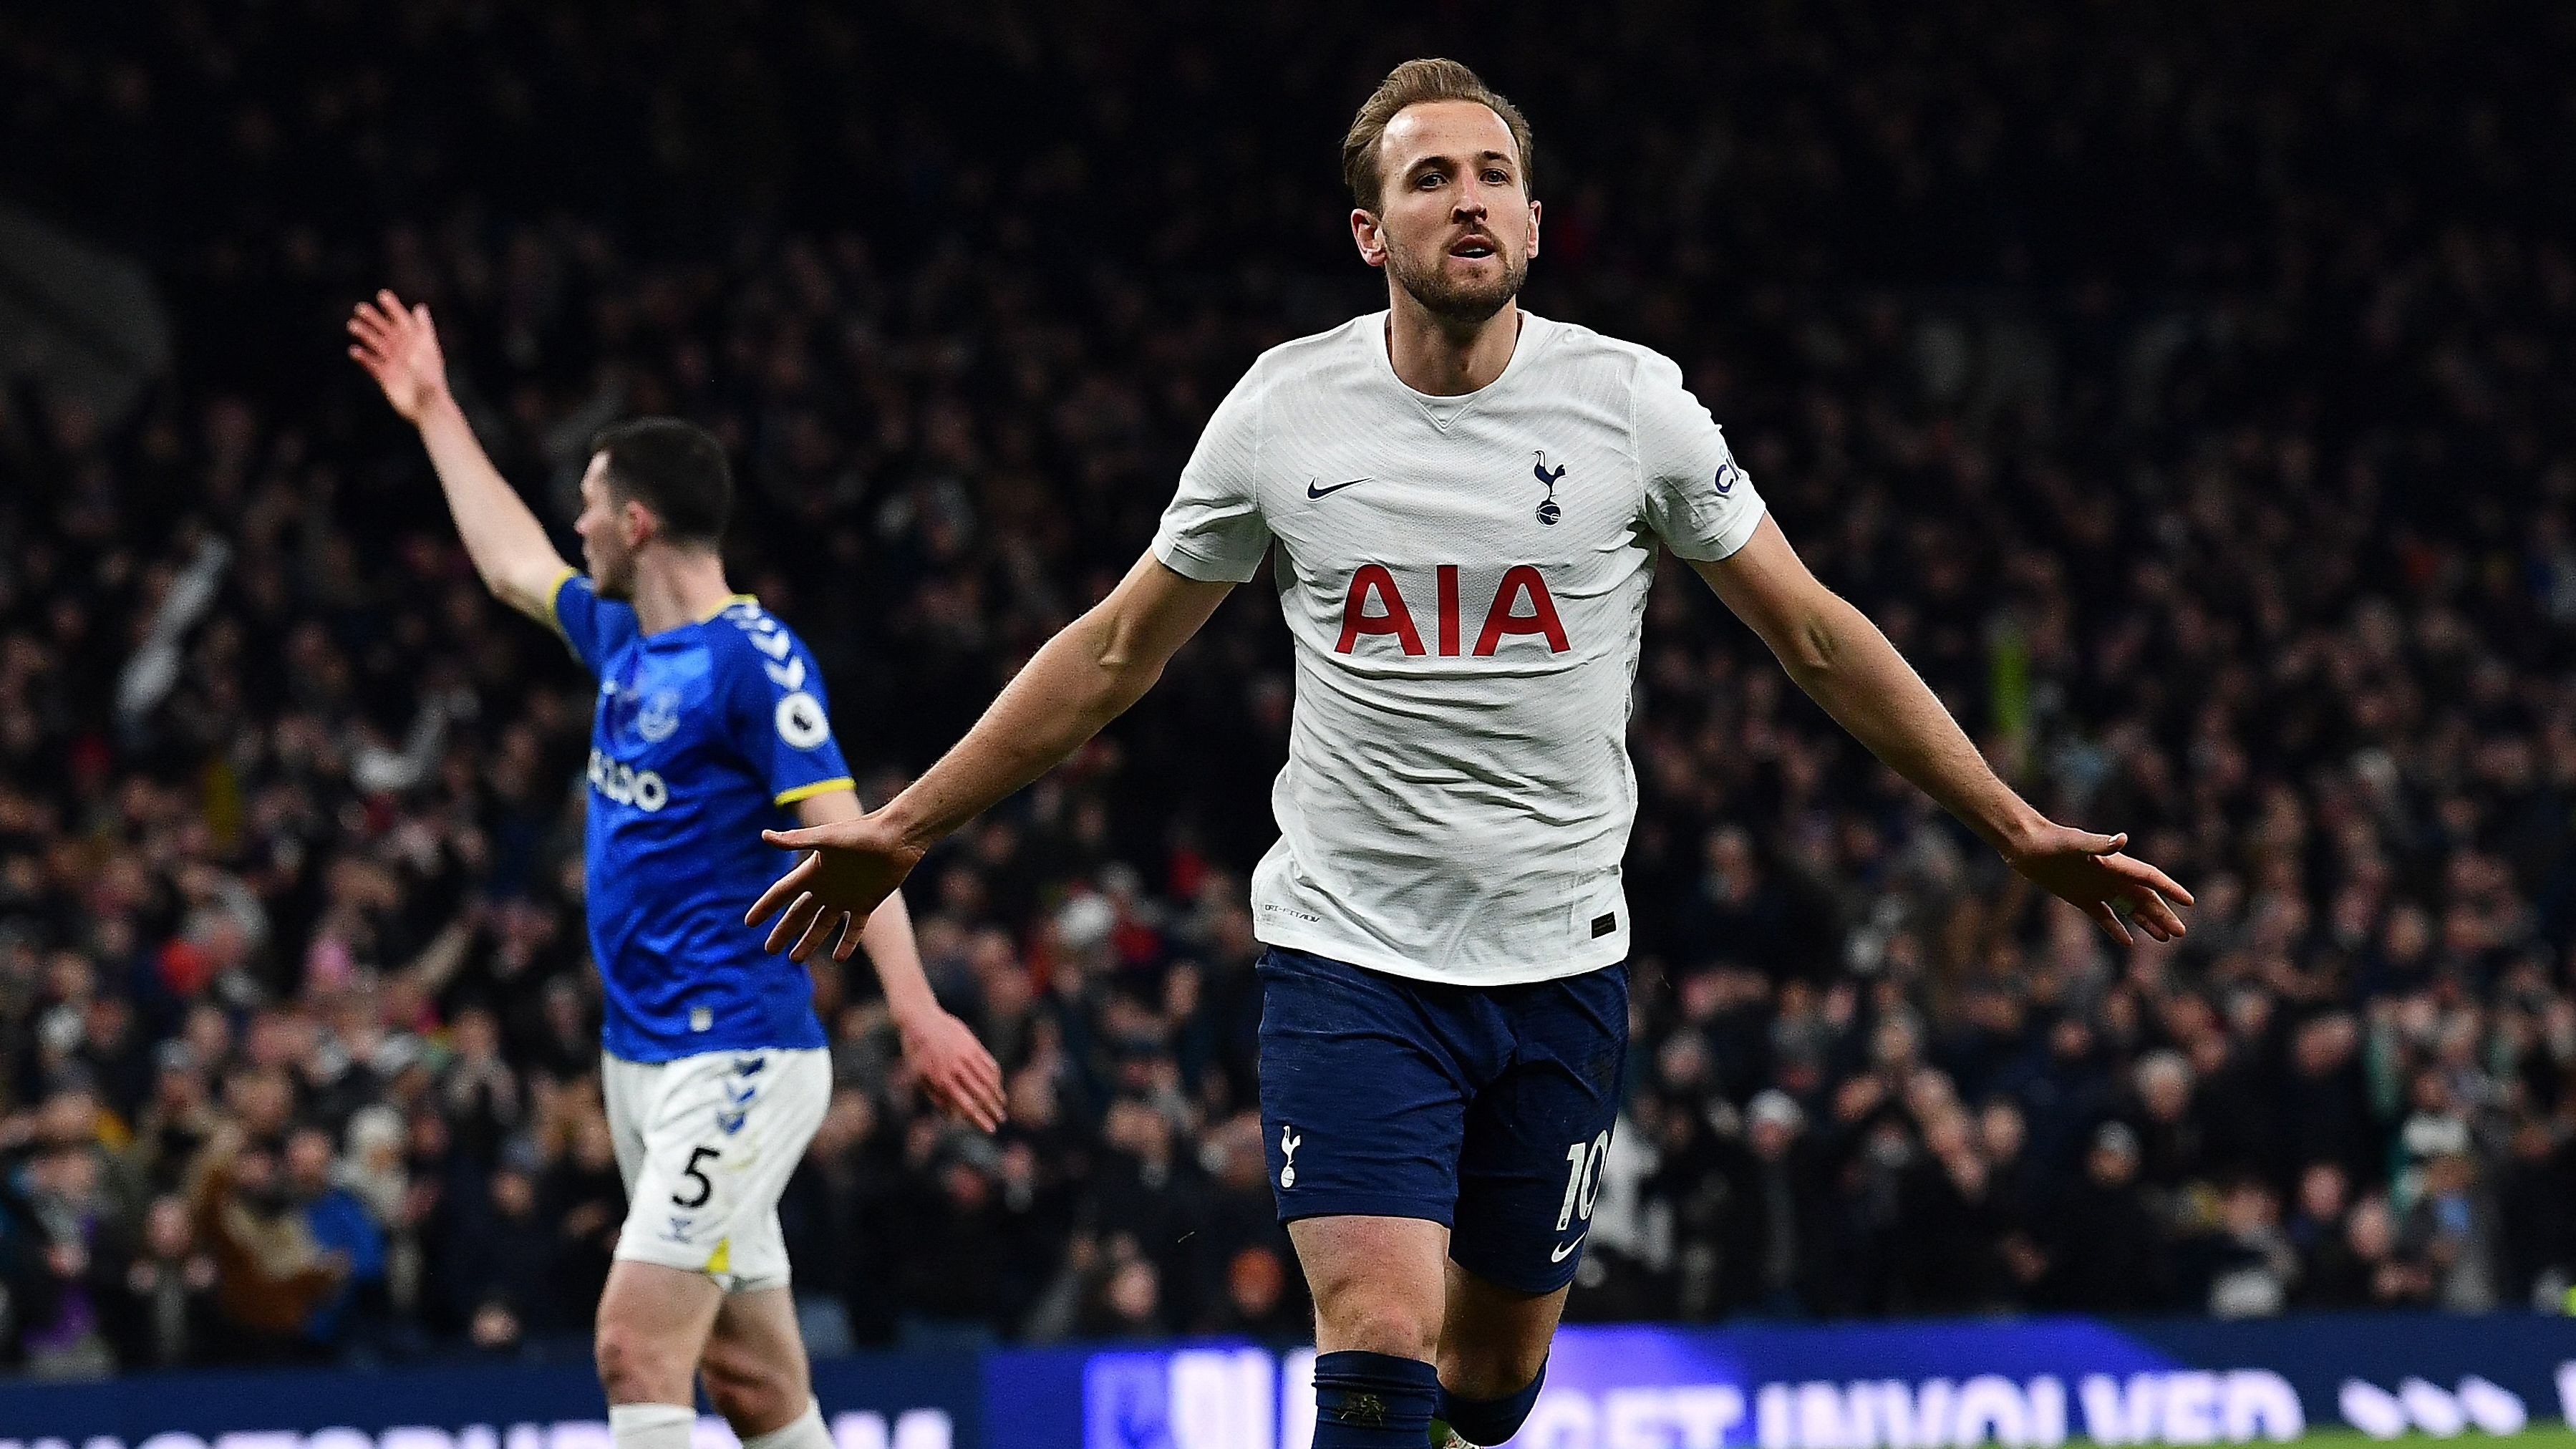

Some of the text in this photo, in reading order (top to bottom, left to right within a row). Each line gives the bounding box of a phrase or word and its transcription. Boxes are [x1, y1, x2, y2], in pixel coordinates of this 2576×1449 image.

[1335, 563, 1571, 656] AIA
[672, 1146, 722, 1208] 5
[1556, 1129, 1608, 1231] 10
